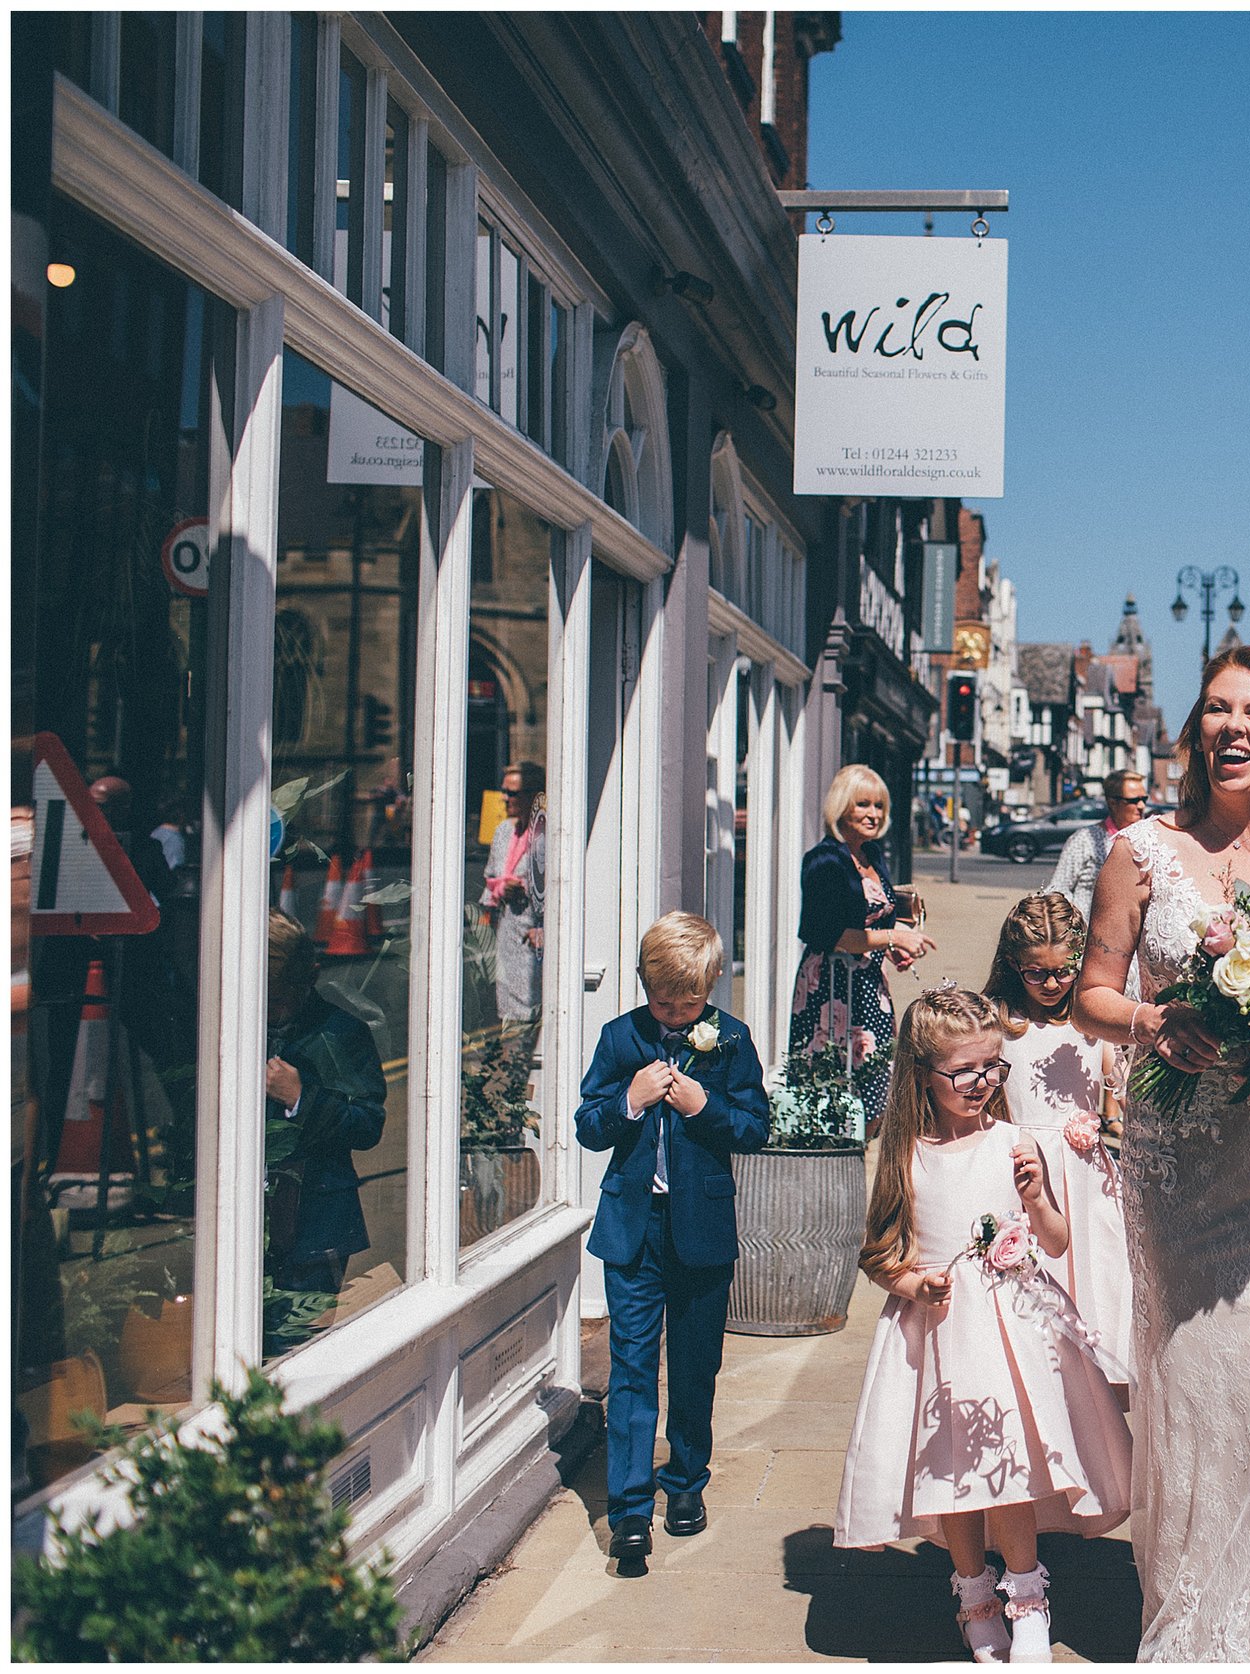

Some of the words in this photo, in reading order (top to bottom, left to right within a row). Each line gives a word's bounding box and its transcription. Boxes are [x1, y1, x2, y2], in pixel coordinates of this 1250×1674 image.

[821, 291, 983, 361] wild
[813, 366, 859, 379] Beautiful
[861, 367, 905, 380] Seasonal
[907, 368, 948, 380] Flowers
[949, 369, 960, 380] &
[962, 369, 989, 381] Gifts
[841, 447, 861, 460] Tel
[871, 448, 909, 461] 01244
[913, 449, 958, 461] 321233
[816, 464, 982, 481] www.wildfloraldesign.co.uk
